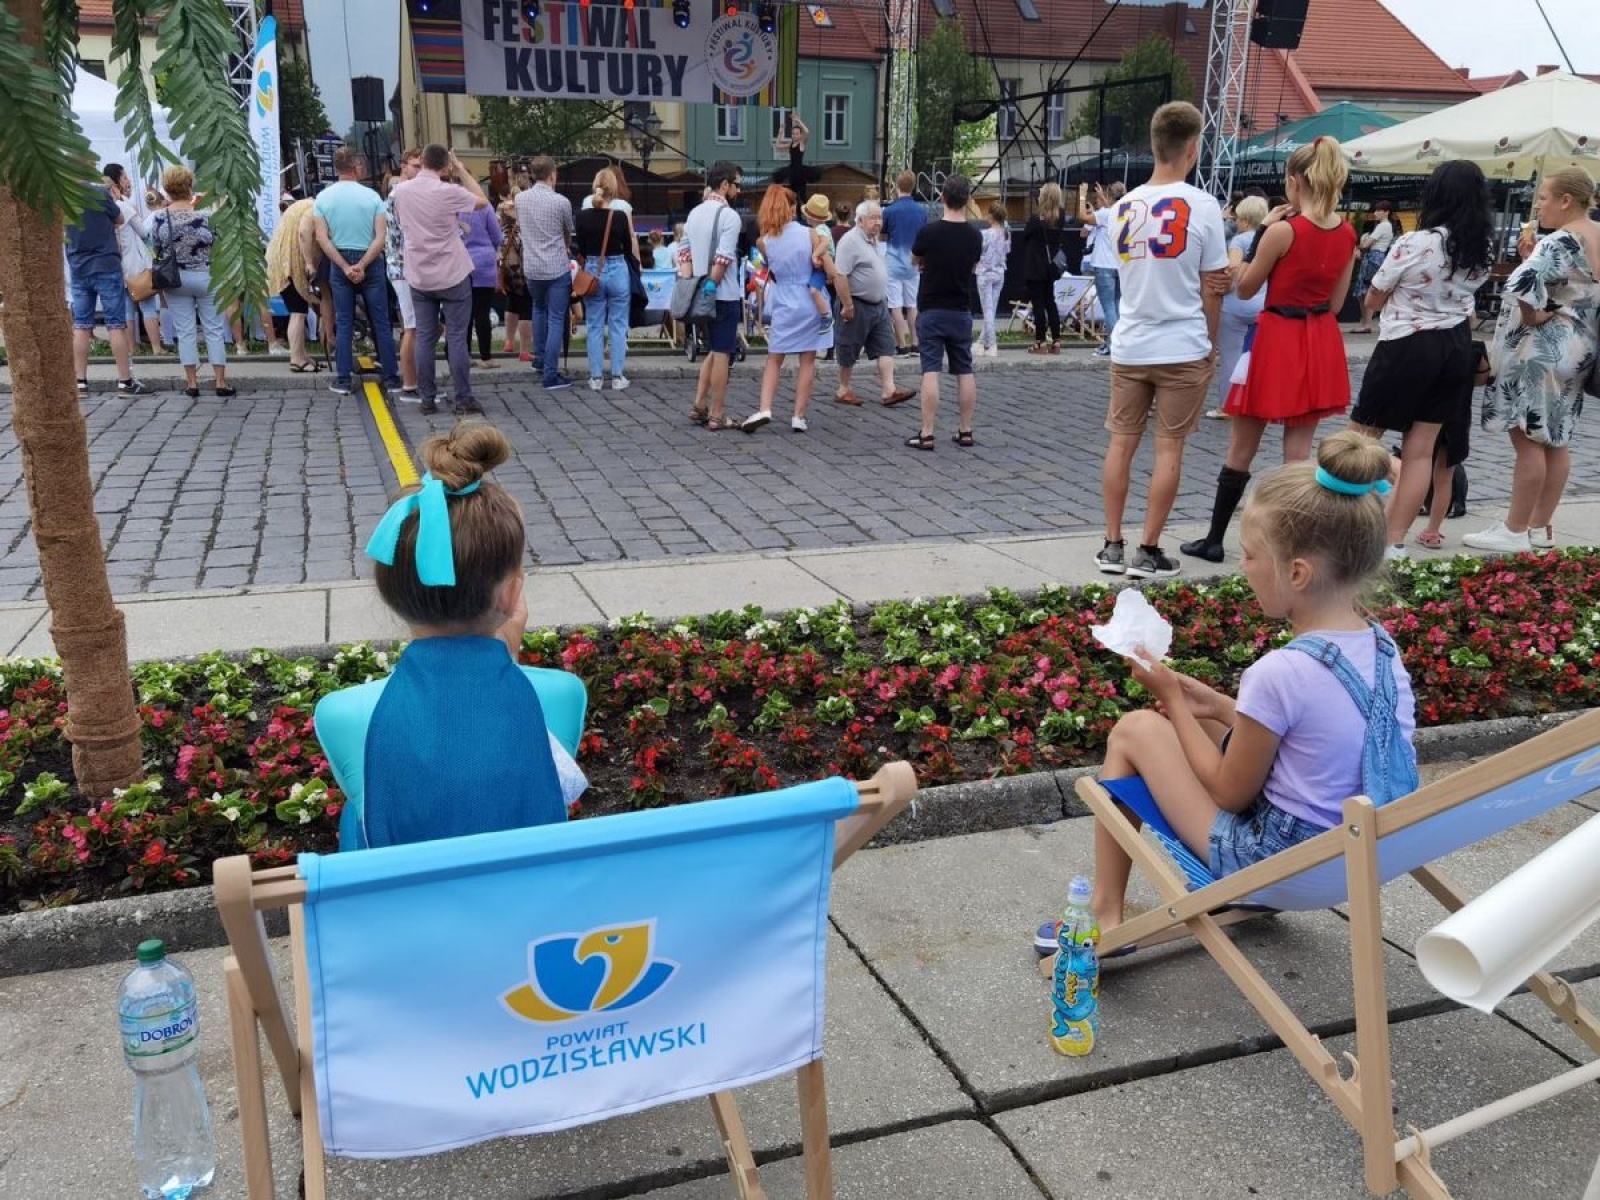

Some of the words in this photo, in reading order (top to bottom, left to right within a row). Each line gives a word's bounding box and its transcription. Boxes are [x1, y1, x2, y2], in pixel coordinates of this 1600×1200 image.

[483, 0, 656, 49] FESTIWAL
[709, 19, 742, 50] FESTIWAL
[504, 46, 689, 97] KULTURY
[261, 127, 274, 238] WODZISŁAWSK
[1117, 197, 1191, 263] 23
[466, 1022, 706, 1099] WODZISŁAWSKI
[547, 1021, 629, 1050] POWIAT
